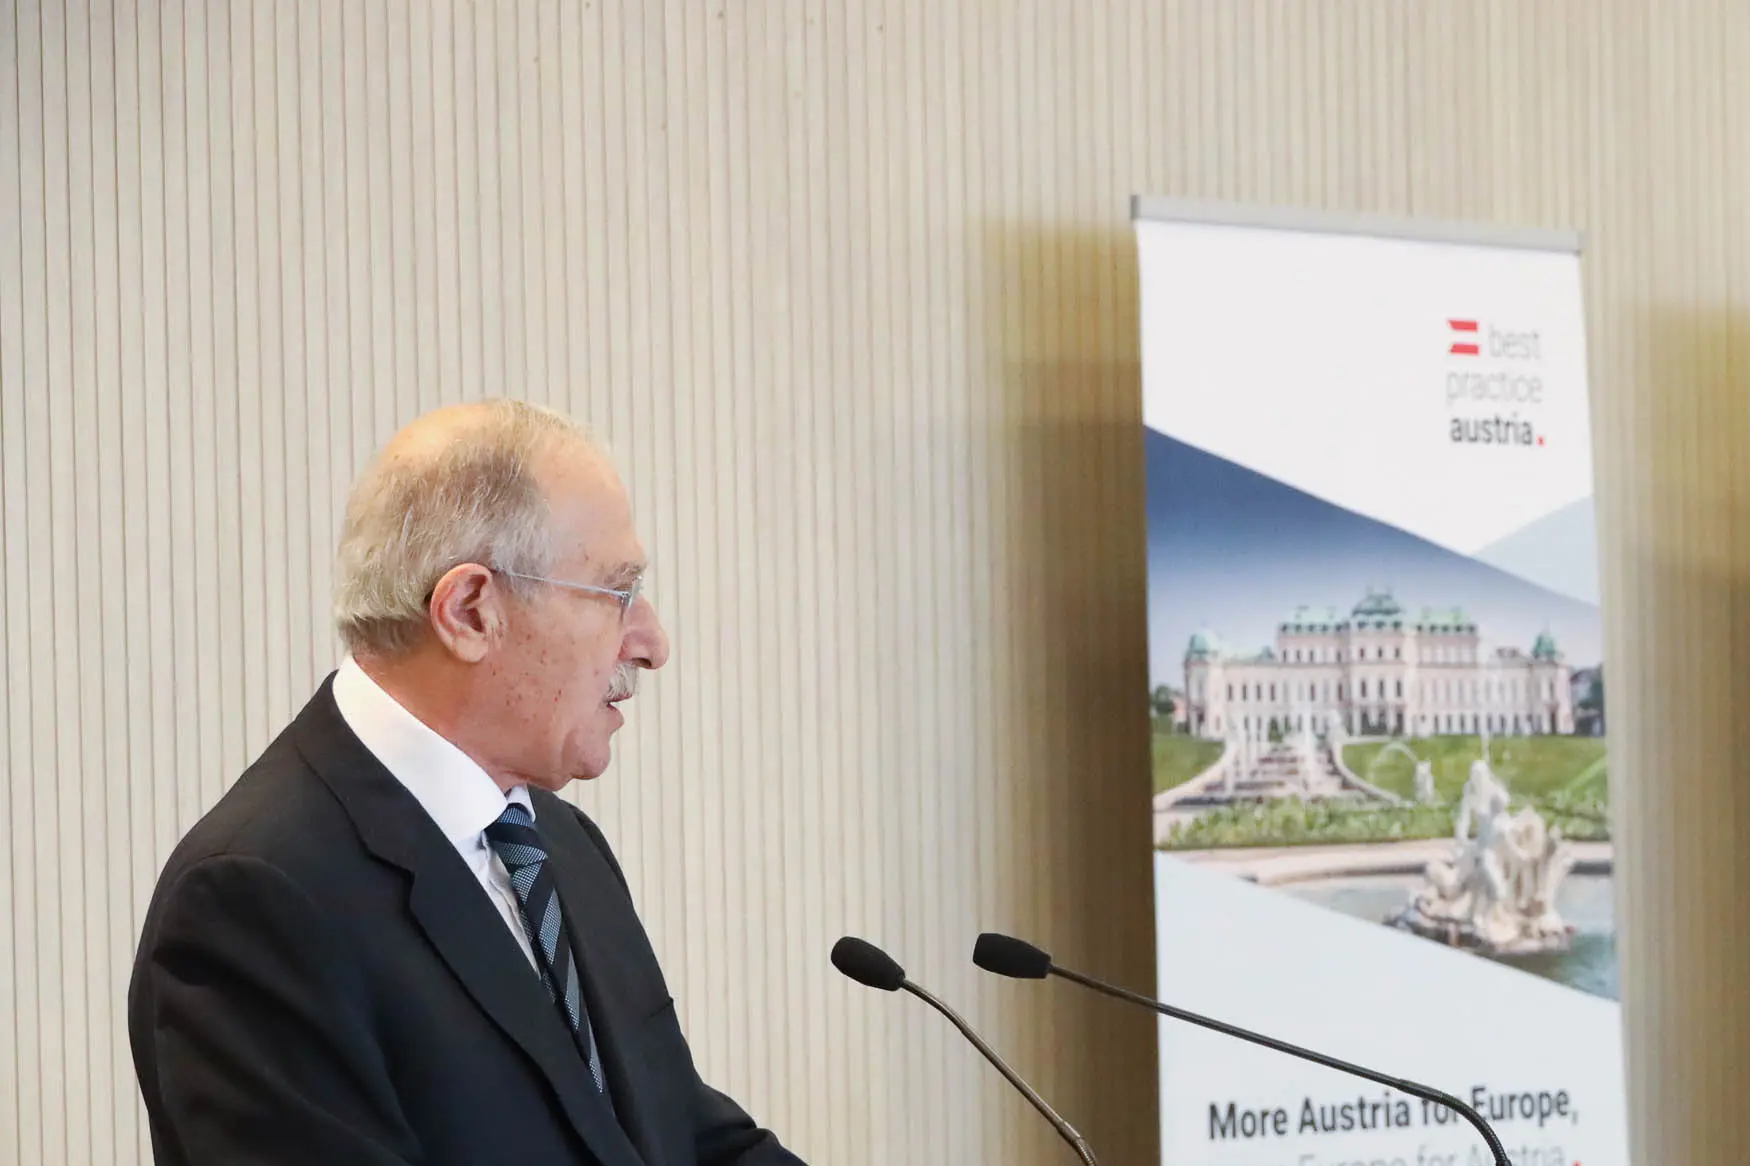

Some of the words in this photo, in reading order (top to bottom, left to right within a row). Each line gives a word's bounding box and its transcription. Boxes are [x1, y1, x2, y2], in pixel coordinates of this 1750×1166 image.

[1488, 324, 1541, 359] best
[1446, 371, 1543, 406] practice
[1208, 1101, 1289, 1140] More
[1299, 1092, 1411, 1134] Austria
[1471, 1085, 1578, 1128] Europe,
